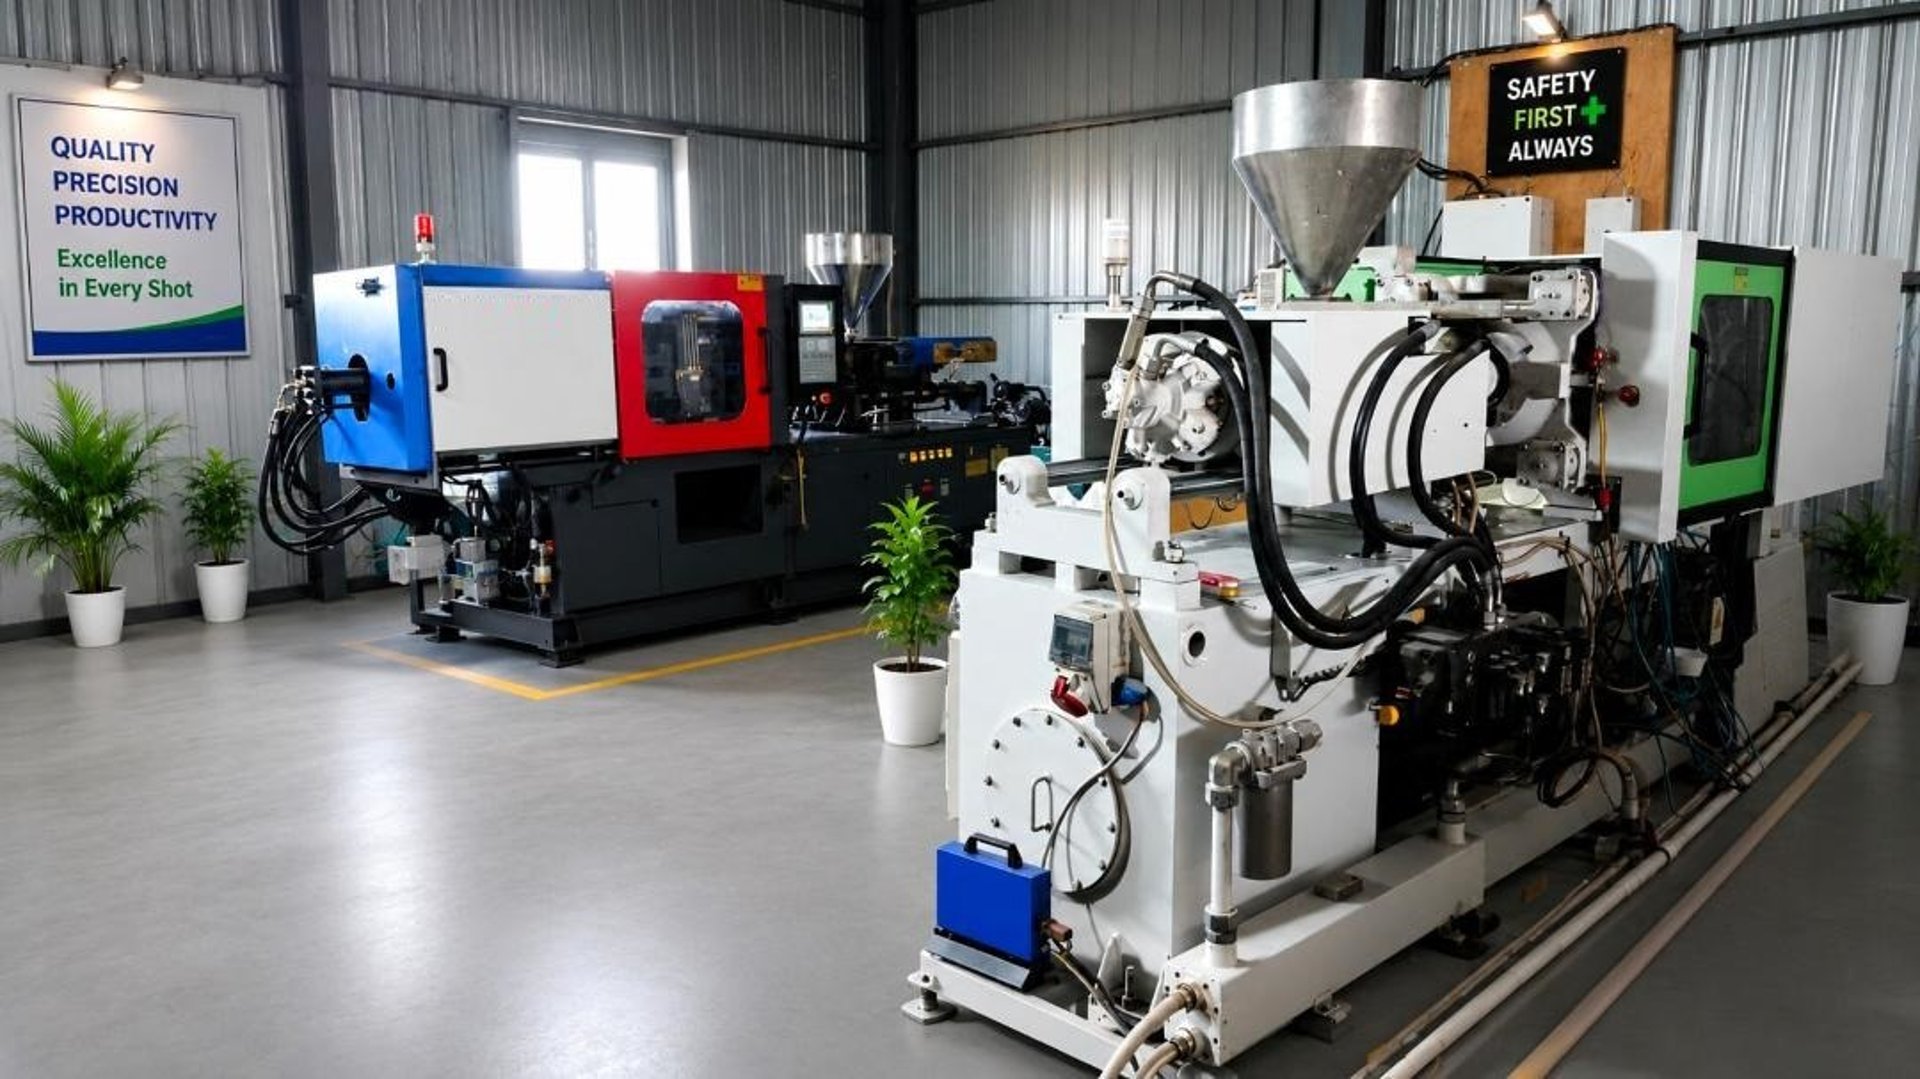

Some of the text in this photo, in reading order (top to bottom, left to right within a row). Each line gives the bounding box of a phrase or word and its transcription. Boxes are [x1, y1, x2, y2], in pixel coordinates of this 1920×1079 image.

[1507, 69, 1596, 100] SAFETY
[1514, 104, 1577, 130] FIRST
[51, 136, 155, 163] QUALITY
[1508, 135, 1594, 162] ALWAYS
[53, 171, 179, 197] PRECISION
[55, 206, 217, 231] PRODUCTIVITY
[57, 249, 167, 269] Excellence
[59, 277, 193, 302] in Every Shot
